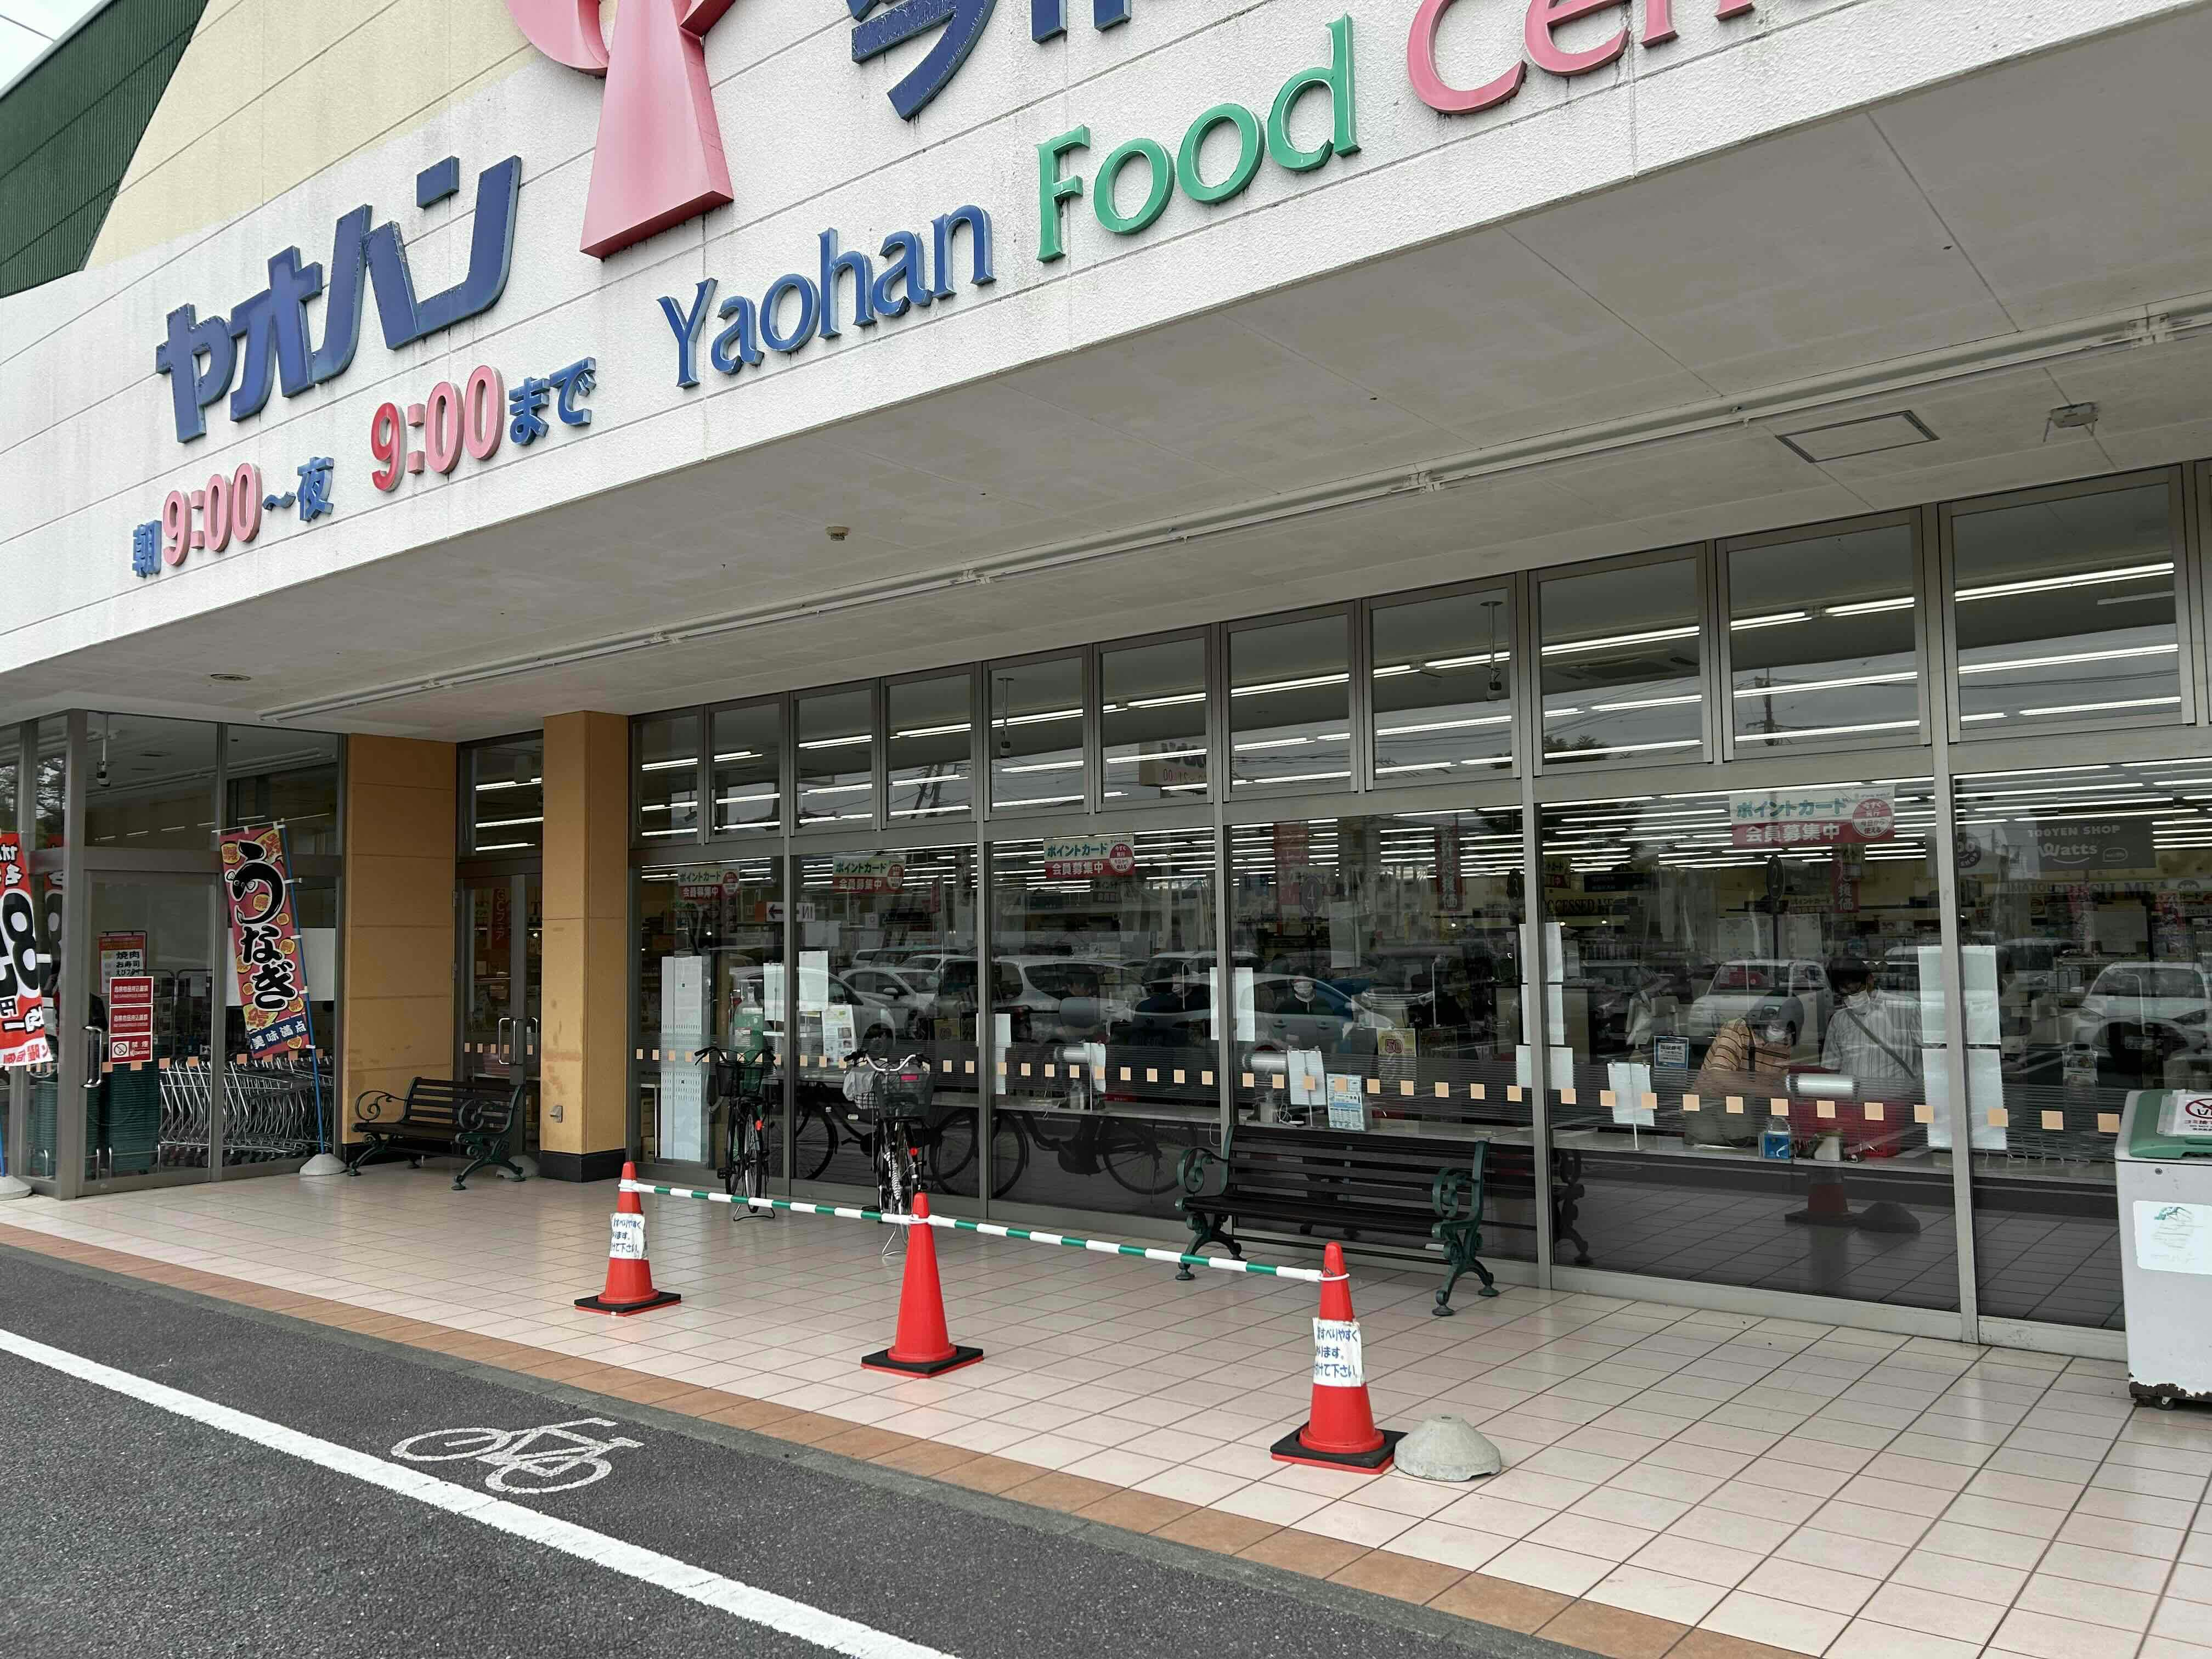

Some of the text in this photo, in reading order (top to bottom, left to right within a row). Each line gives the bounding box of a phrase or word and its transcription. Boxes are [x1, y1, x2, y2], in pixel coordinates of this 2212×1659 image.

[657, 204, 997, 389] Yaohan
[1036, 13, 1361, 263] Food
[155, 155, 522, 443] ヤオハン
[1737, 797, 1847, 819] ポイントカード
[1746, 823, 1839, 842] 会員募集中
[2083, 825, 2120, 834] SHOP
[1048, 842, 1108, 857] ポイントカード
[2039, 842, 2098, 857] Watts
[836, 862, 887, 874] ポイントカード
[1053, 861, 1104, 875] 会員募集中
[839, 878, 882, 890] 会員募集中
[225, 839, 297, 1011] うなぎ
[116, 951, 140, 960] 焼肉
[116, 960, 140, 968] お寿司
